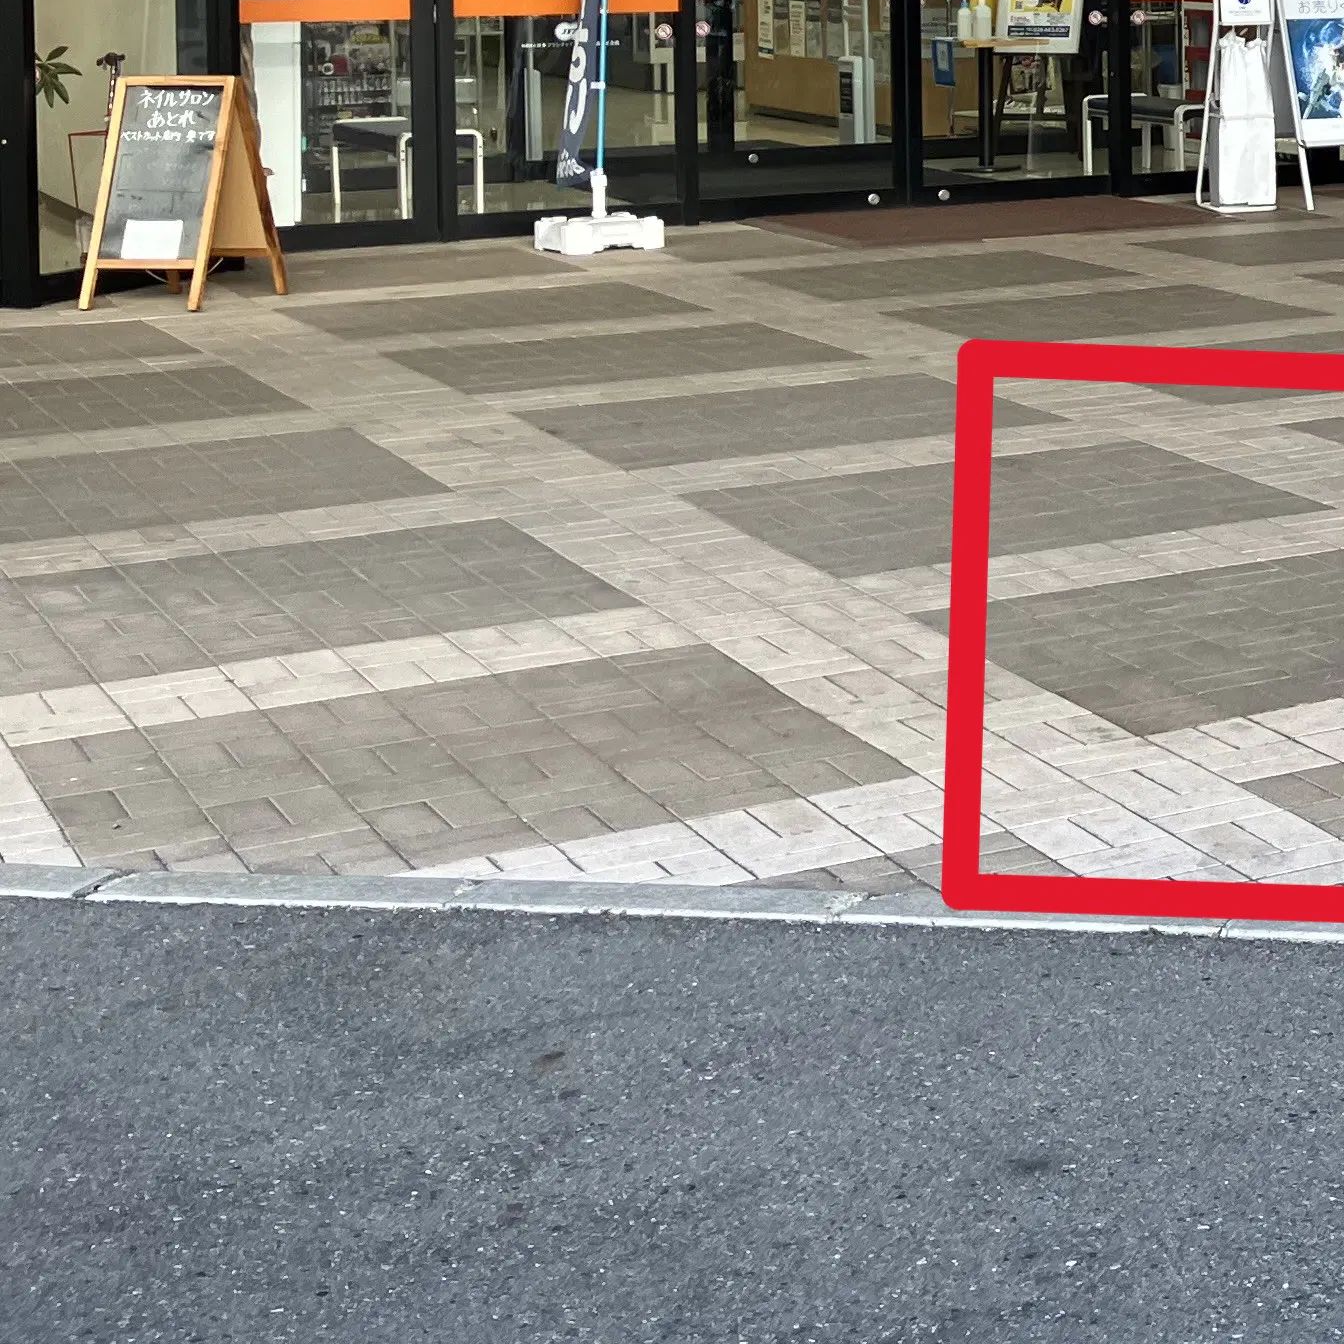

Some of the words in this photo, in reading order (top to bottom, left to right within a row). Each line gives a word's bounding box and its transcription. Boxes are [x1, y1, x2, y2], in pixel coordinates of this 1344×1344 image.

[137, 89, 215, 109] ネイルサロン
[146, 110, 197, 129] あとれ
